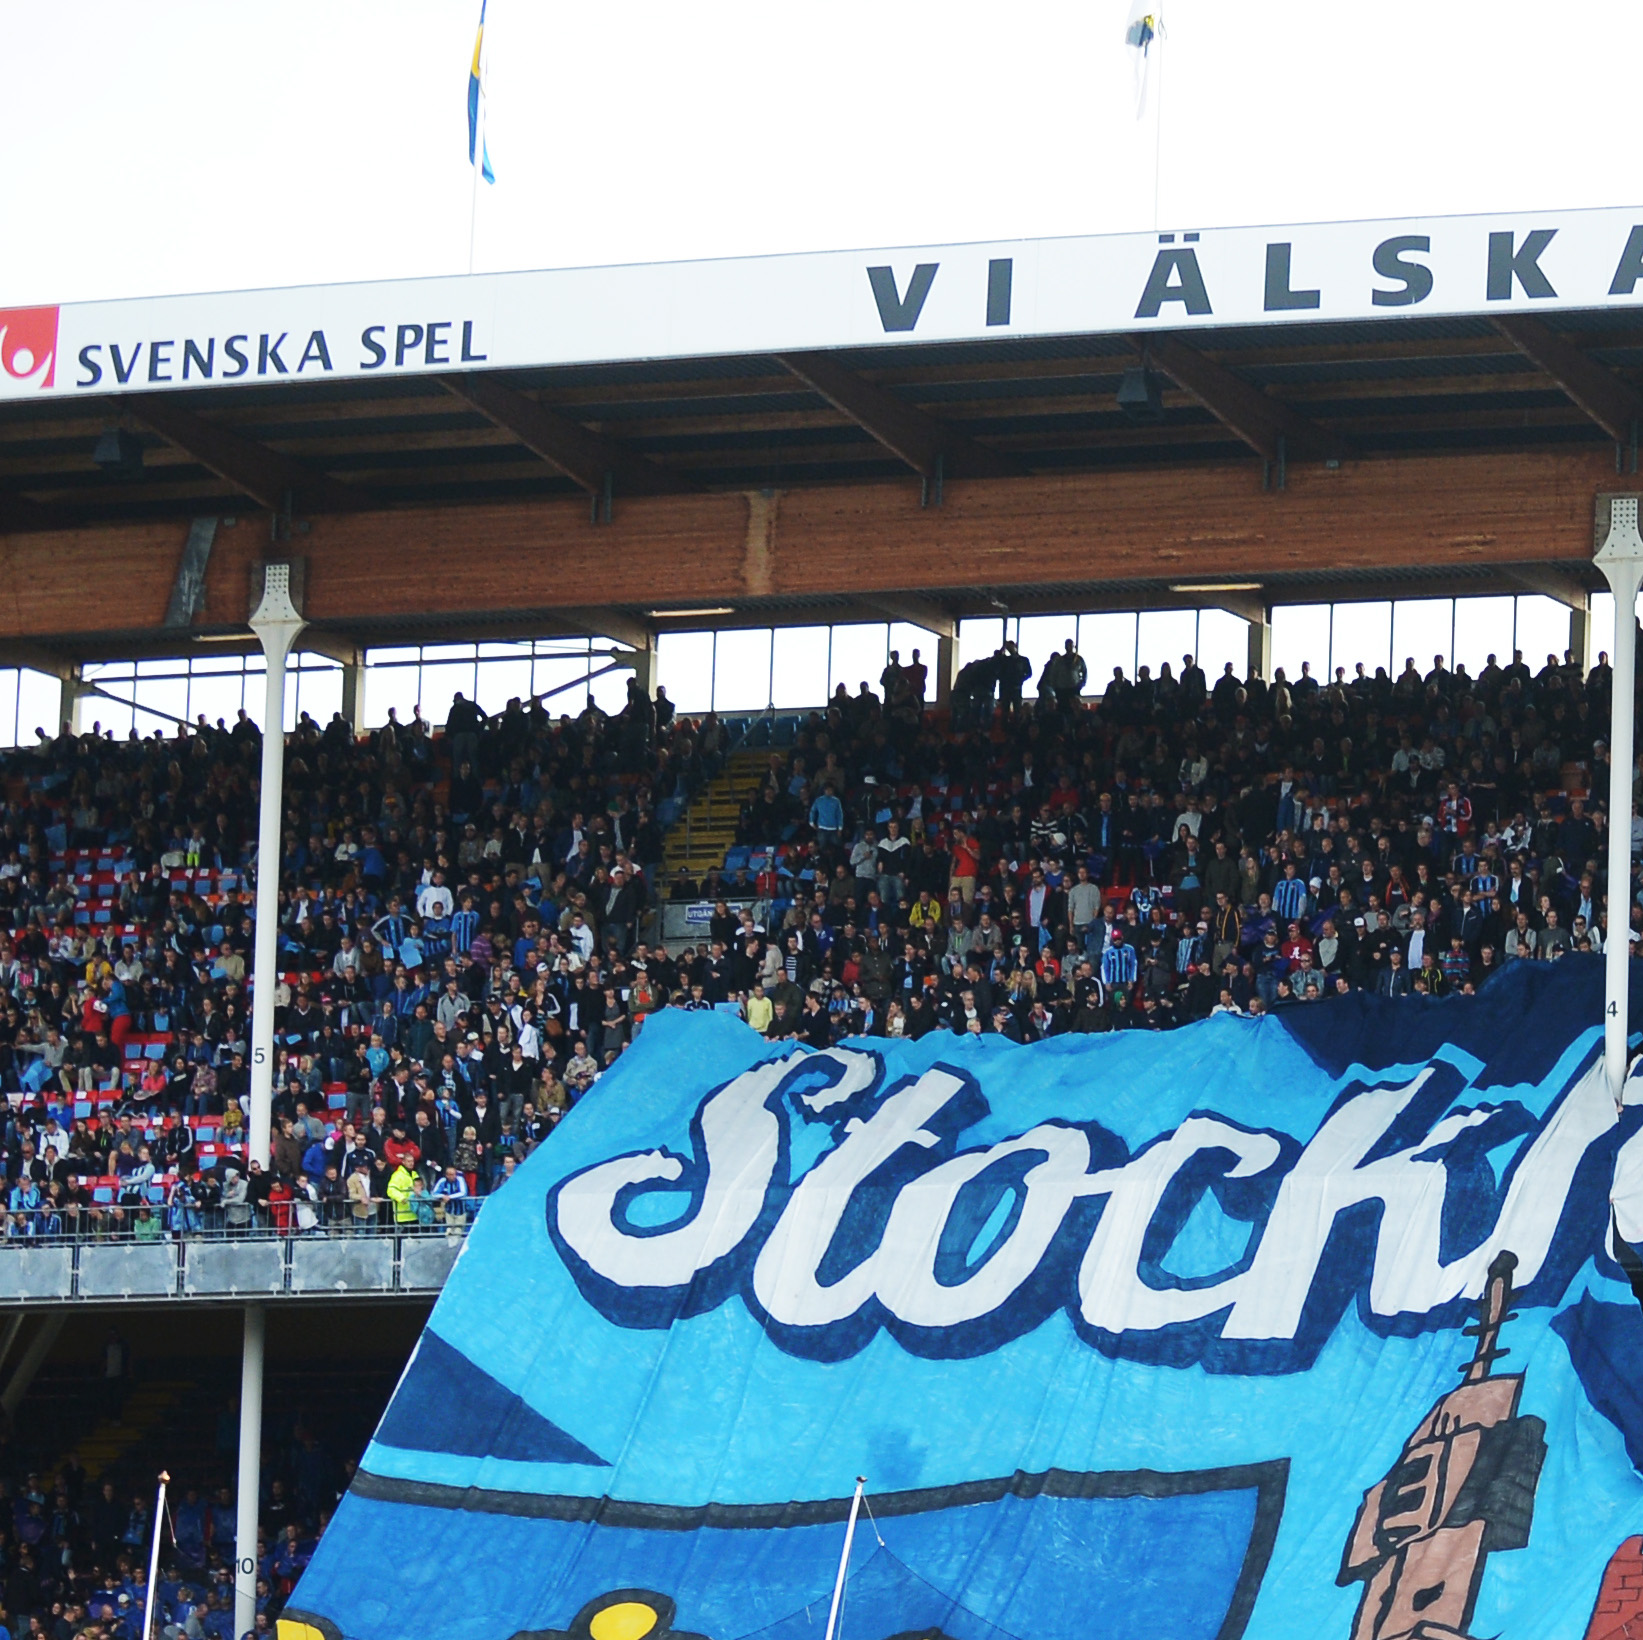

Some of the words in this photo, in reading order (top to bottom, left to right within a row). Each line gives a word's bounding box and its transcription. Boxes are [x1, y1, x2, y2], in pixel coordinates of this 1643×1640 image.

[866, 258, 1012, 332] VI
[76, 329, 334, 388] SVENSKA
[359, 319, 488, 369] SPEL
[1607, 1000, 1618, 1017] 4
[254, 1047, 265, 1064] 5
[236, 1557, 254, 1575] 10
